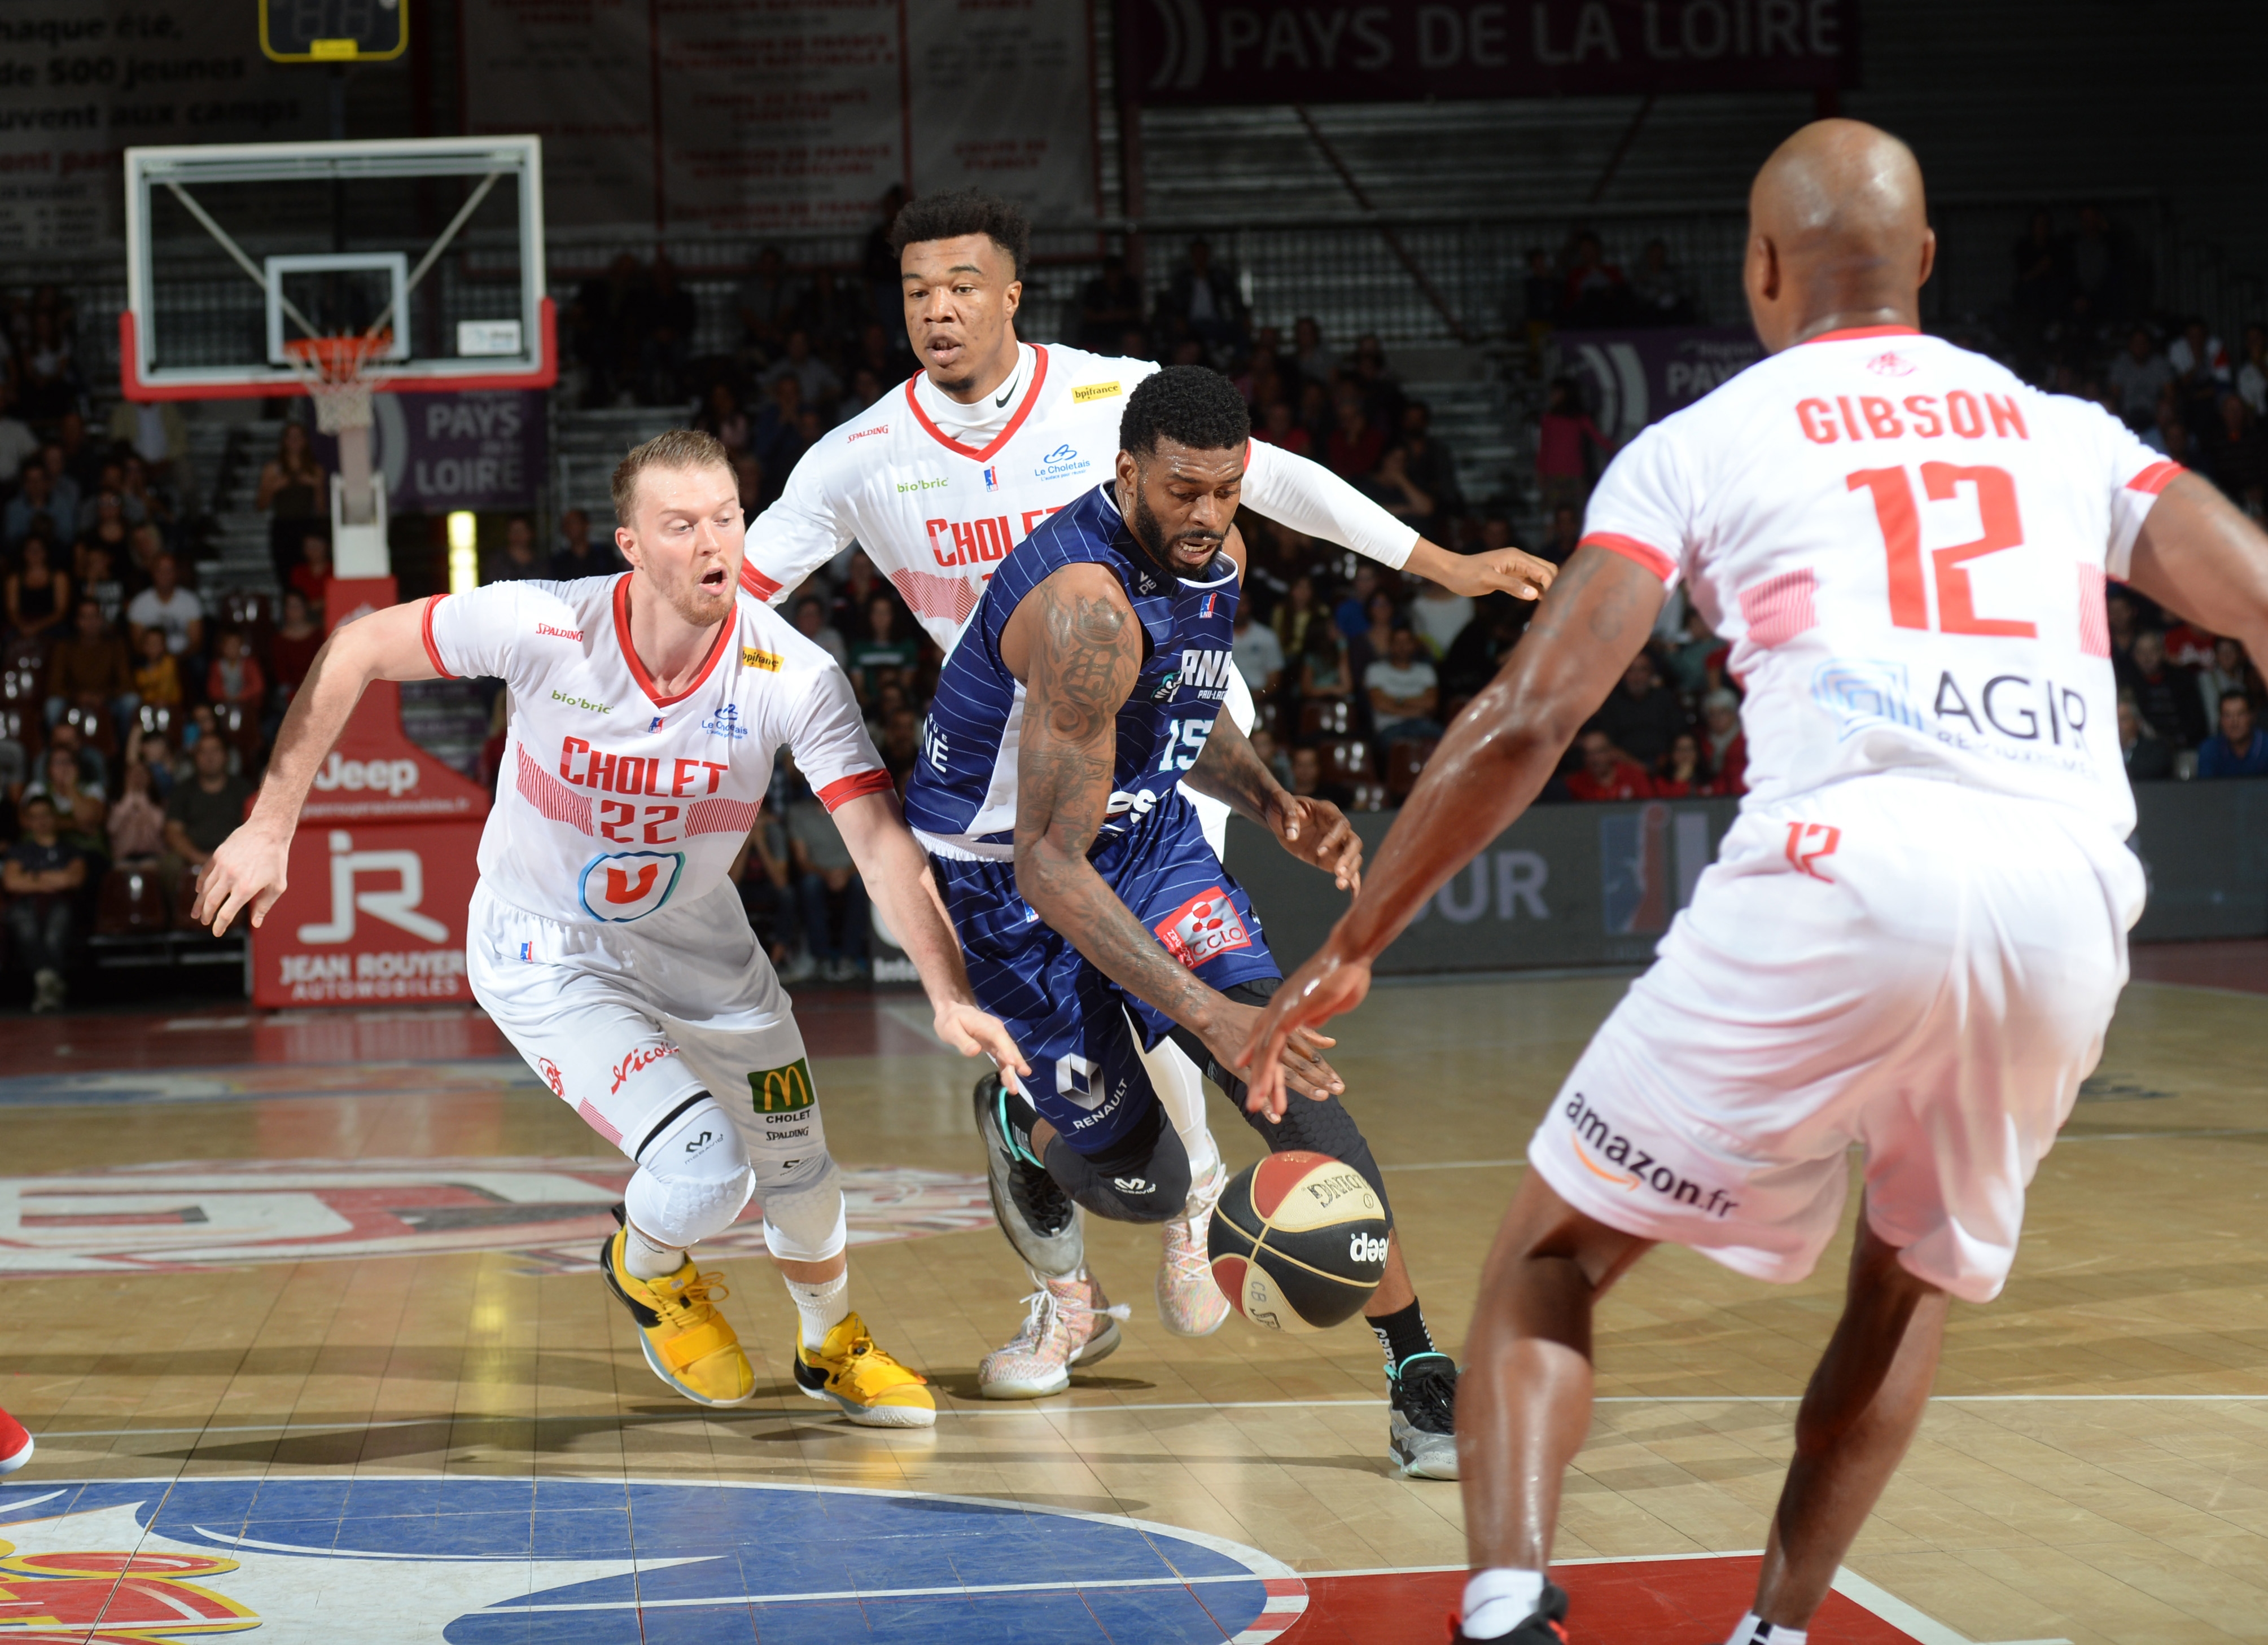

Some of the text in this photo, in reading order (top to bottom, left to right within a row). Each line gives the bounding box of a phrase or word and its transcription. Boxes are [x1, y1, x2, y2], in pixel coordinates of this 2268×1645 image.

[1218, 0, 1845, 71] PAYS DE LA LOIRE
[48, 55, 116, 85] 500
[1074, 383, 1119, 400] bpifrance
[1665, 360, 1749, 397] PAY
[426, 401, 523, 441] PAYS
[847, 424, 888, 444] SPALDING
[1796, 389, 2030, 446] GIBSON
[414, 457, 525, 497] LOIRE
[897, 477, 948, 494] bio'bric
[1034, 459, 1091, 477] Le Choletais
[926, 506, 1071, 567] CHOL
[1845, 460, 2038, 639] 12
[536, 623, 584, 642] SPALDING
[551, 690, 613, 714] bio'bric
[1934, 670, 2090, 751] AGIR
[1158, 718, 1215, 772] 15
[314, 752, 419, 797] Jeep
[559, 735, 729, 798] CHOLET
[600, 799, 680, 845] 22
[1785, 821, 1842, 885] 12
[1412, 849, 1551, 925] UR
[1193, 927, 1244, 957] CCLO
[279, 954, 351, 985] JEAN
[766, 1109, 811, 1124] CHOLET
[1072, 1078, 1127, 1130] RENAULT
[766, 1126, 809, 1142] SPALDING
[1565, 1092, 1739, 1218] amazon.fr
